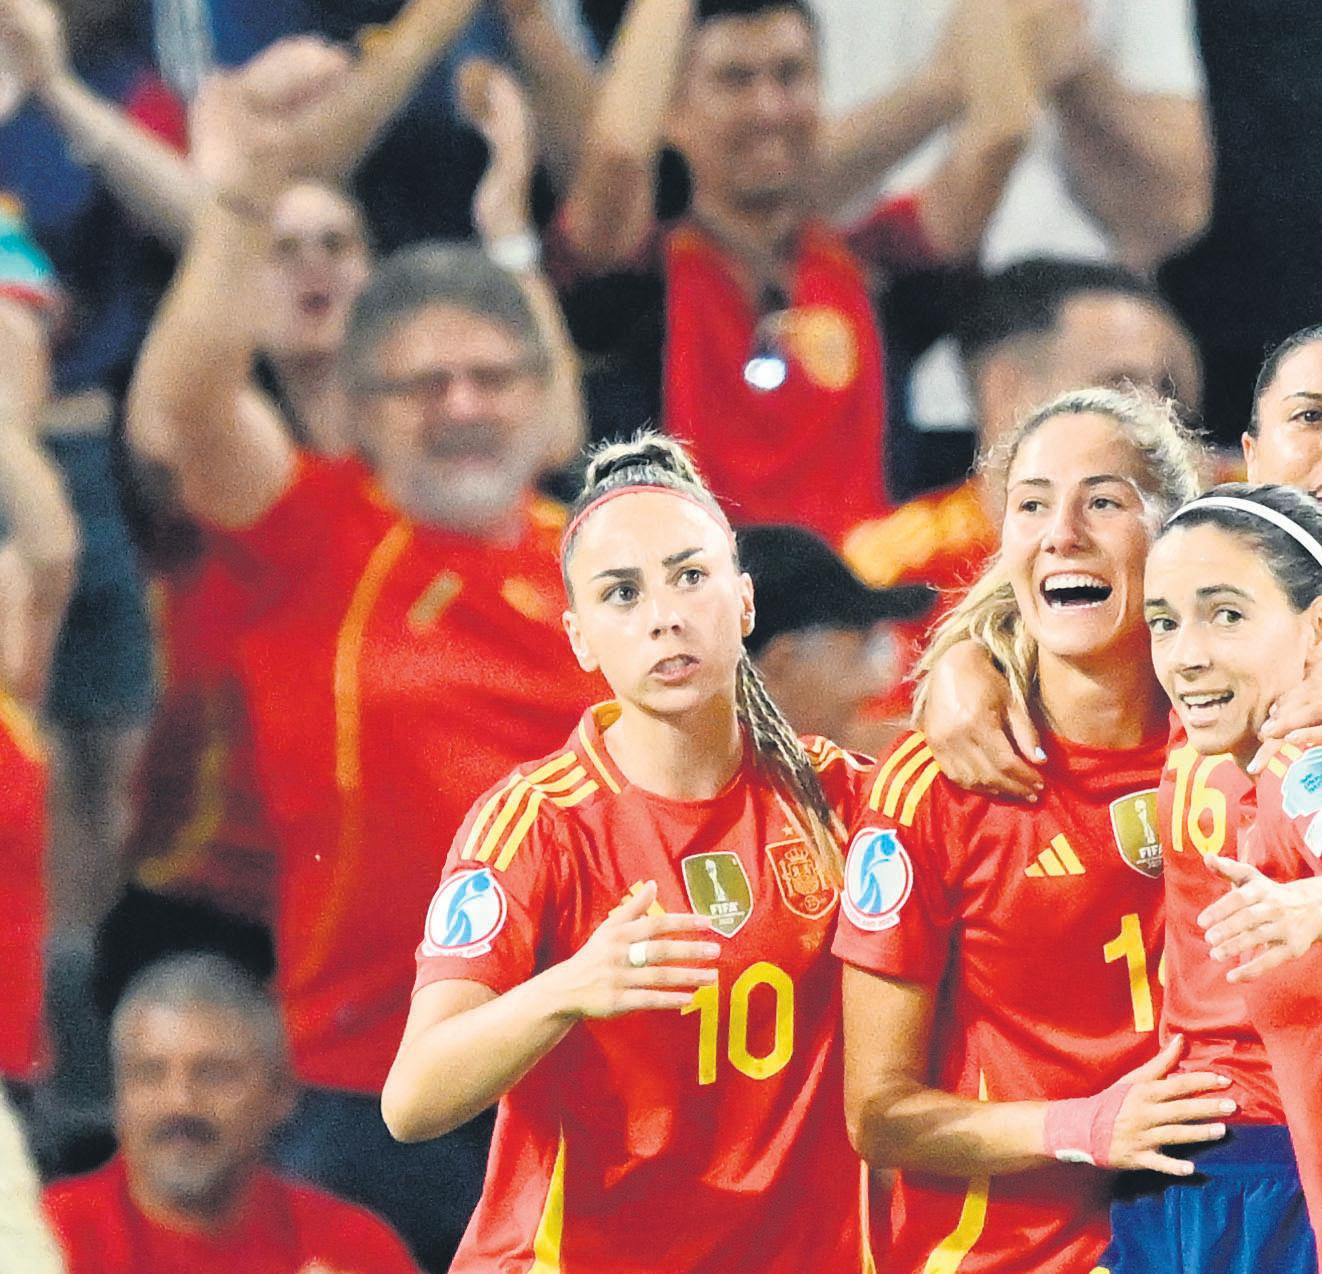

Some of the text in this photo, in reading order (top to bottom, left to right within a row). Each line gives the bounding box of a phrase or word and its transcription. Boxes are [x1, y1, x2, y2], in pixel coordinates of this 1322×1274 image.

[1168, 743, 1234, 856] 16
[709, 902, 739, 916] FIFA
[680, 961, 794, 1086] 10
[1103, 912, 1166, 1032] 1
